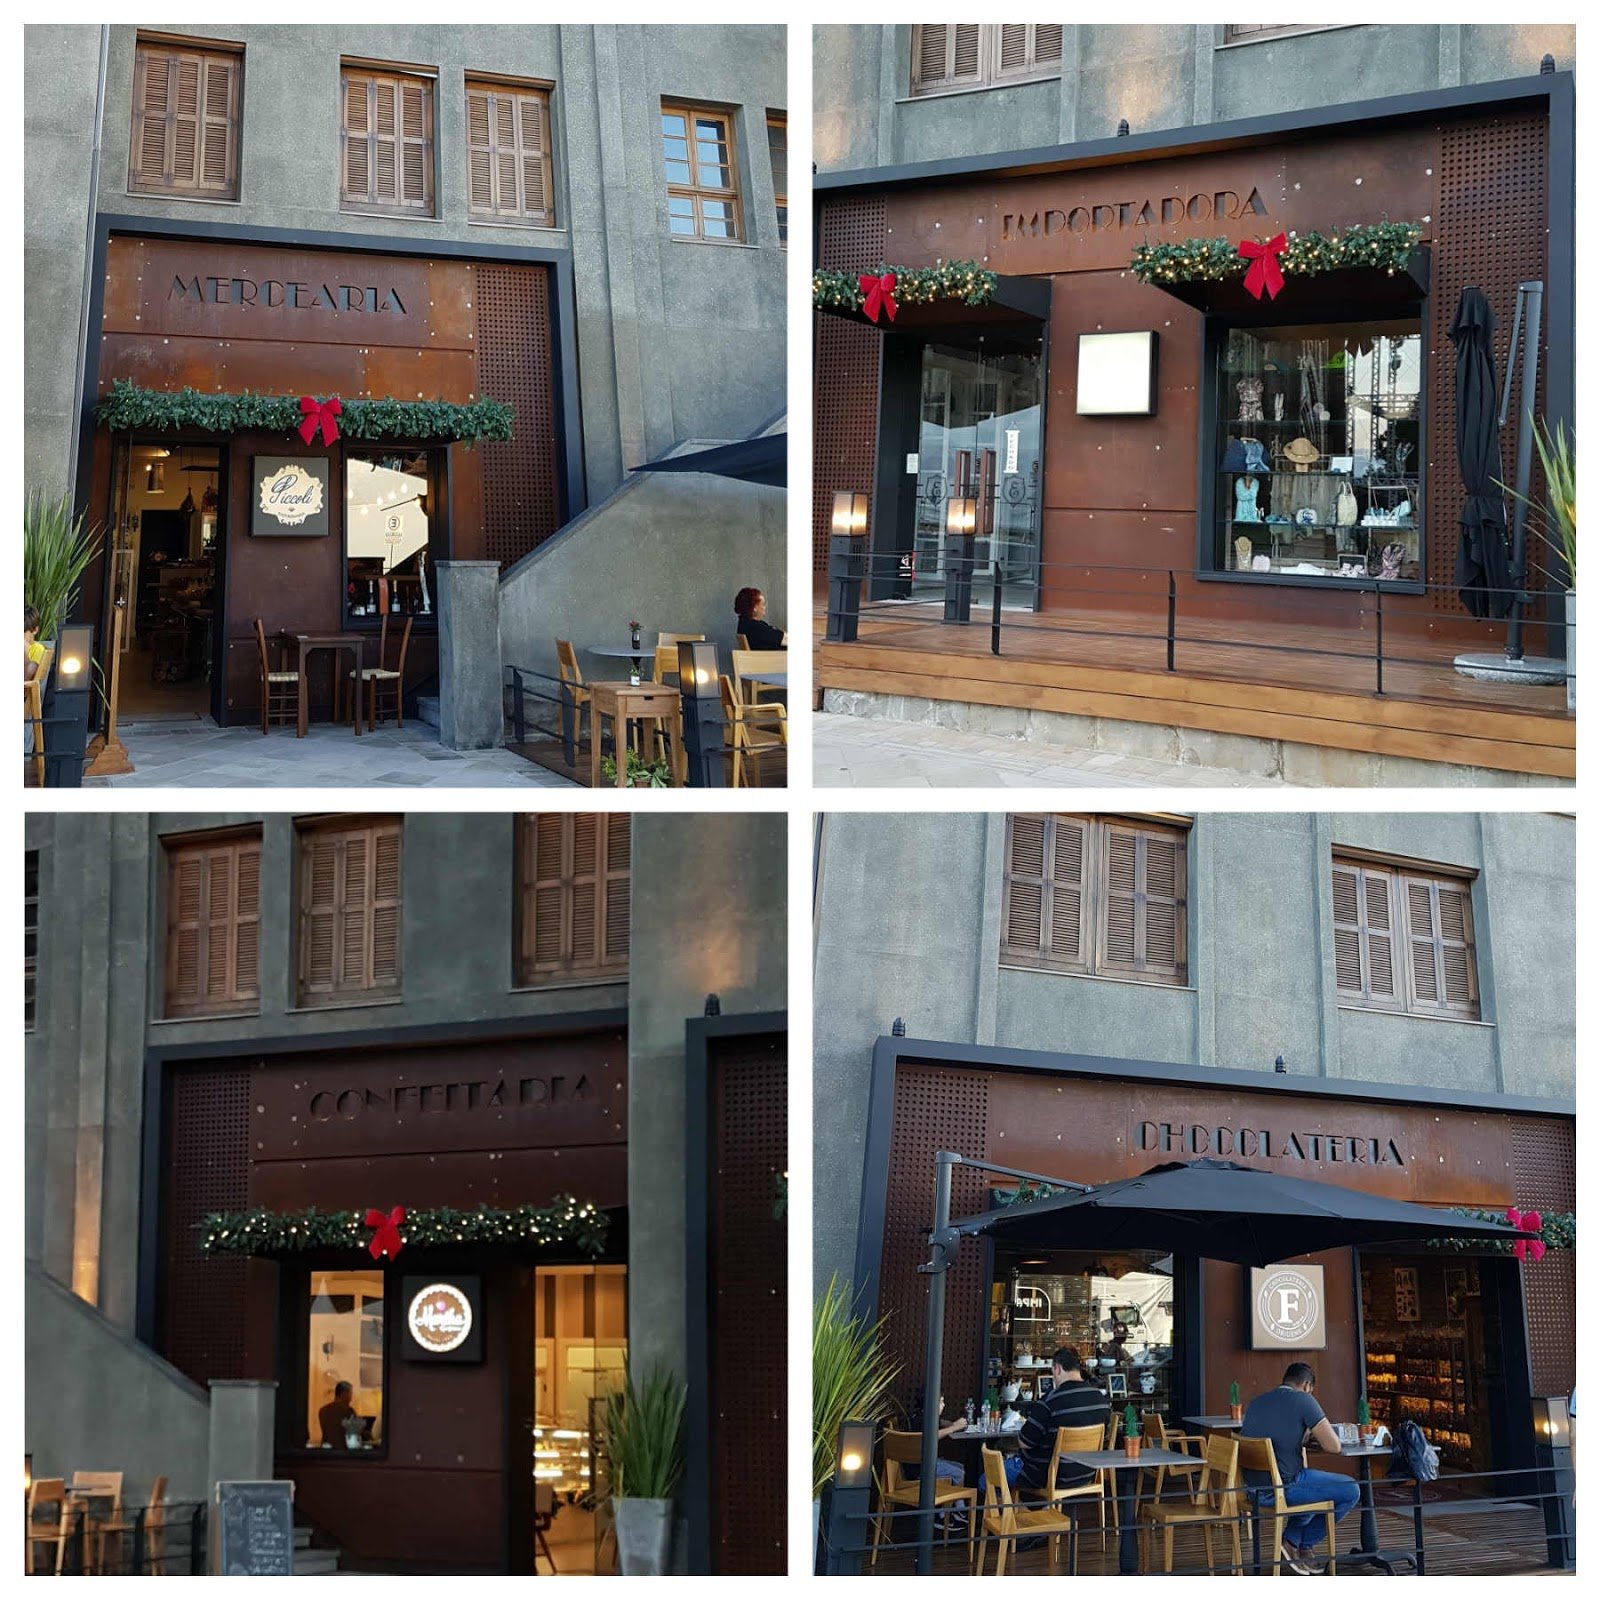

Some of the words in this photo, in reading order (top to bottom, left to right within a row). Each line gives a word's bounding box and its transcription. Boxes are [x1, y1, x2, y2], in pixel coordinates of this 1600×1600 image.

[1003, 186, 1269, 241] IMPORTADORA
[167, 274, 408, 314] MERCEARIA
[269, 474, 314, 504] Piccoli
[310, 1074, 590, 1121] CONFEITARIA
[1135, 1121, 1404, 1166] CHOCOLATERIA
[1277, 1288, 1300, 1324] F
